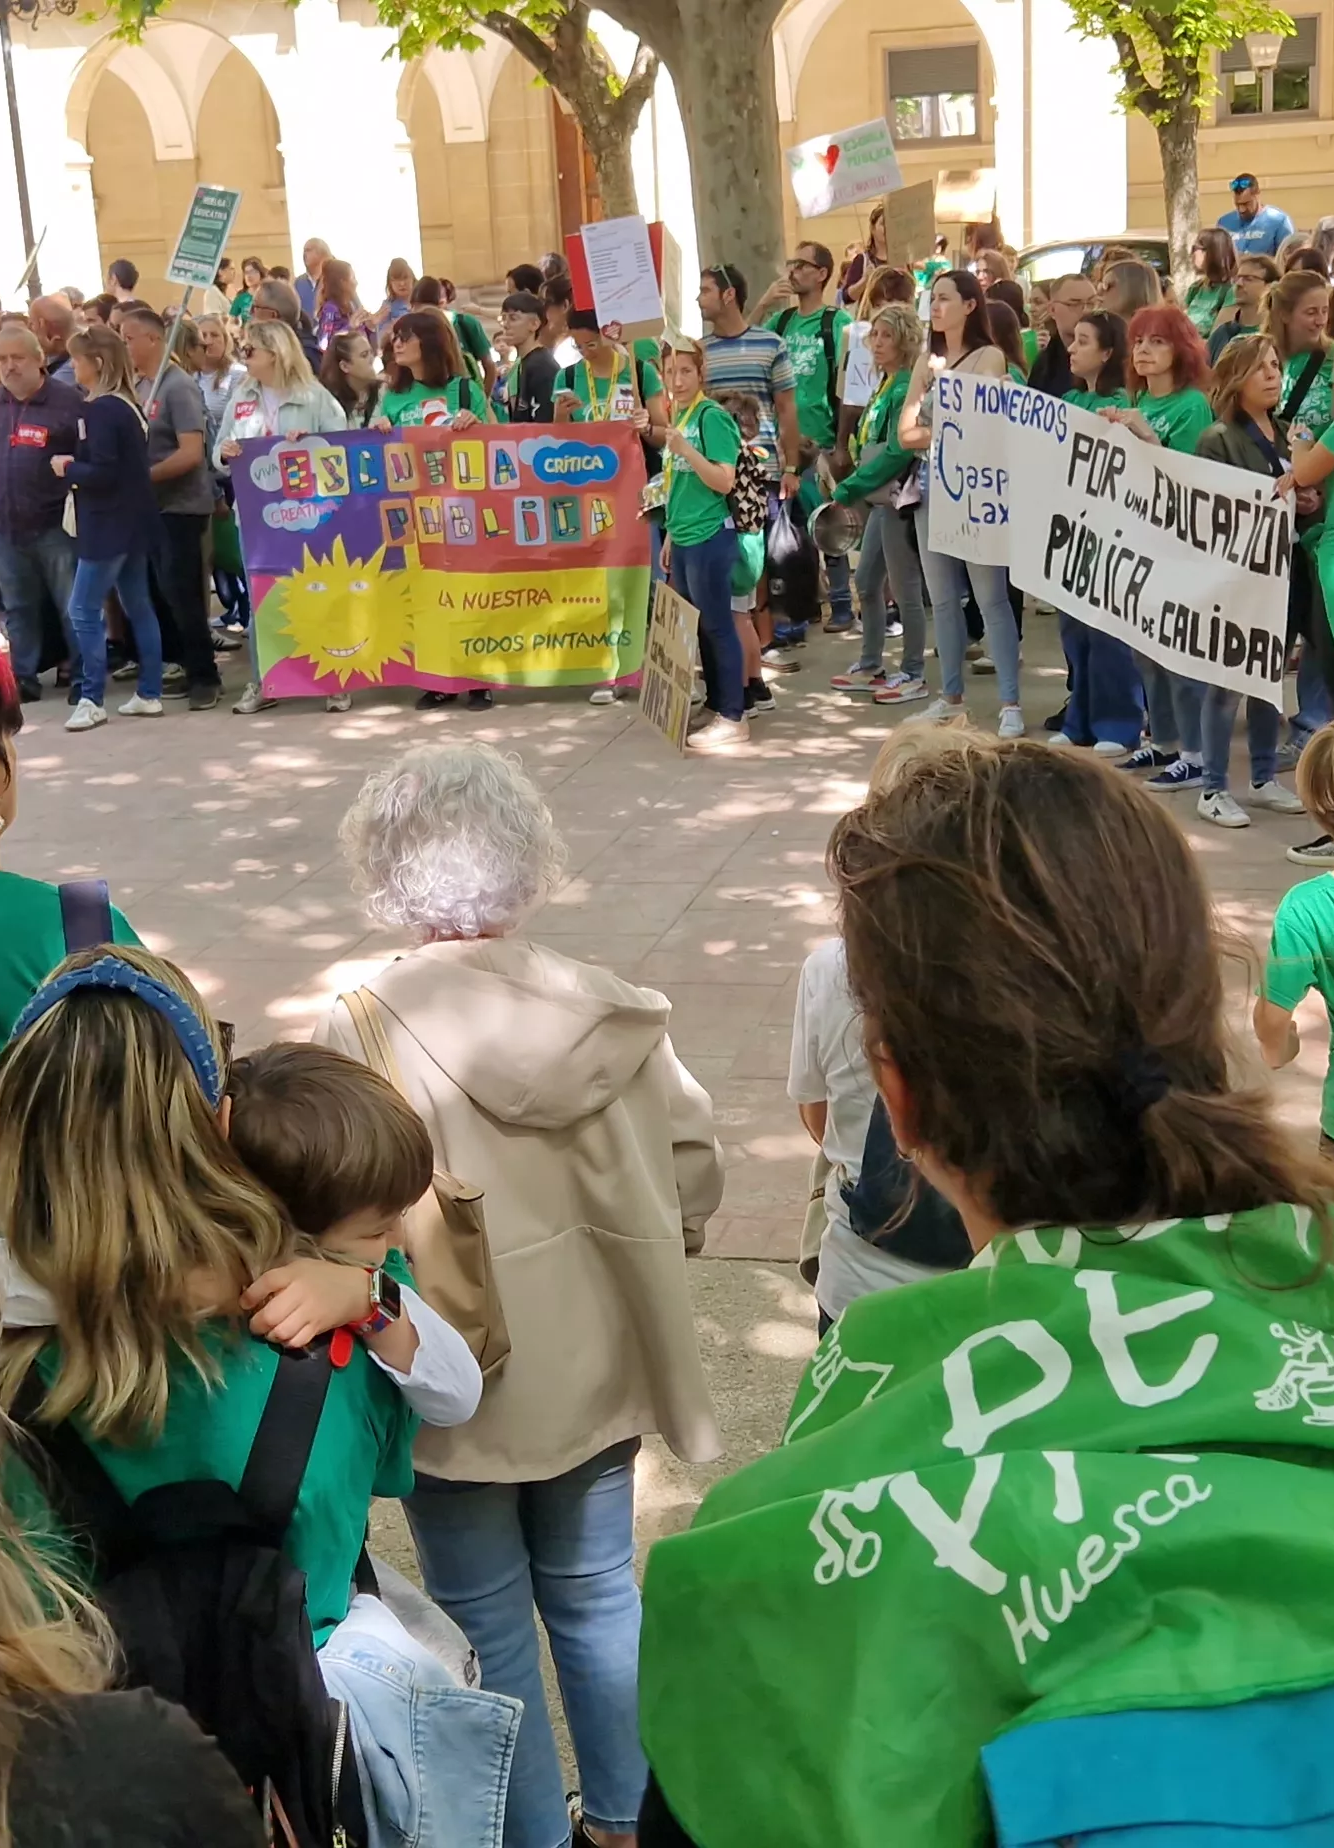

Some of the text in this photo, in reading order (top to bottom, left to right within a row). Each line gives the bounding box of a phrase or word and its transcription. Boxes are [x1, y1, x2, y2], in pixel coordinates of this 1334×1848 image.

[938, 377, 1068, 444] ES MONEGROS
[254, 448, 605, 493] VIVA ESCUELA CRÍTICA
[1067, 432, 1126, 503] POR
[1124, 489, 1149, 522] UNA
[270, 499, 340, 524] CREATI
[968, 494, 1009, 526] Lax
[438, 590, 455, 609] LA
[463, 588, 553, 611] NUESTRA
[460, 630, 632, 657] TODOS PINTAMOS
[1141, 615, 1156, 639] DE
[1158, 599, 1284, 683] CALIDAD
[1000, 1472, 1213, 1664] Huesca
